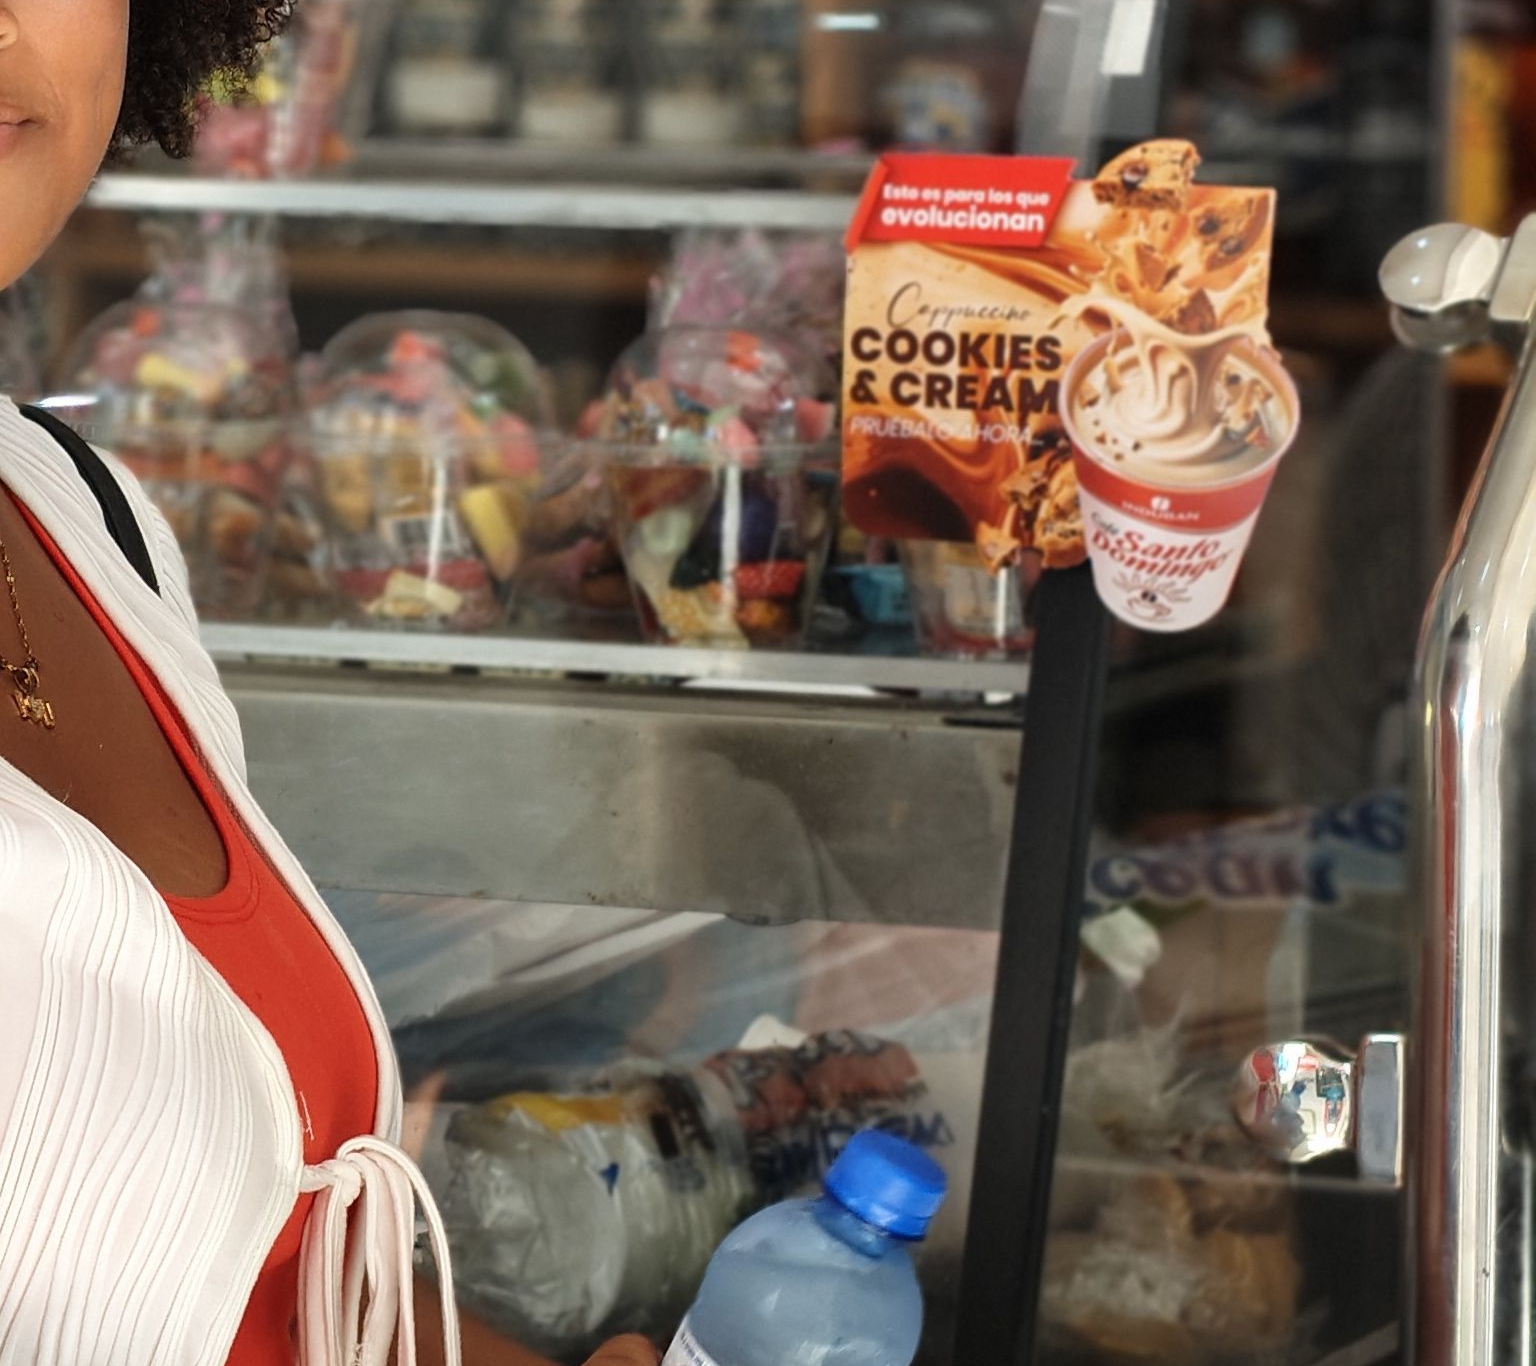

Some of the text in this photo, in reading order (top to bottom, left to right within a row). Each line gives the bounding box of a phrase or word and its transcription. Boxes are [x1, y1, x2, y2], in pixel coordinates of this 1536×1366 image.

[881, 205, 1045, 232] evolucionan
[921, 188, 941, 202] es
[943, 187, 984, 206] para
[988, 188, 1013, 205] los
[1015, 191, 1051, 209] que
[886, 282, 1031, 328] Cappuccino
[850, 327, 1062, 372] COOKIES
[849, 369, 1060, 414] & CREAM
[1092, 528, 1235, 586] Domingo
[1115, 529, 1222, 561] Santo
